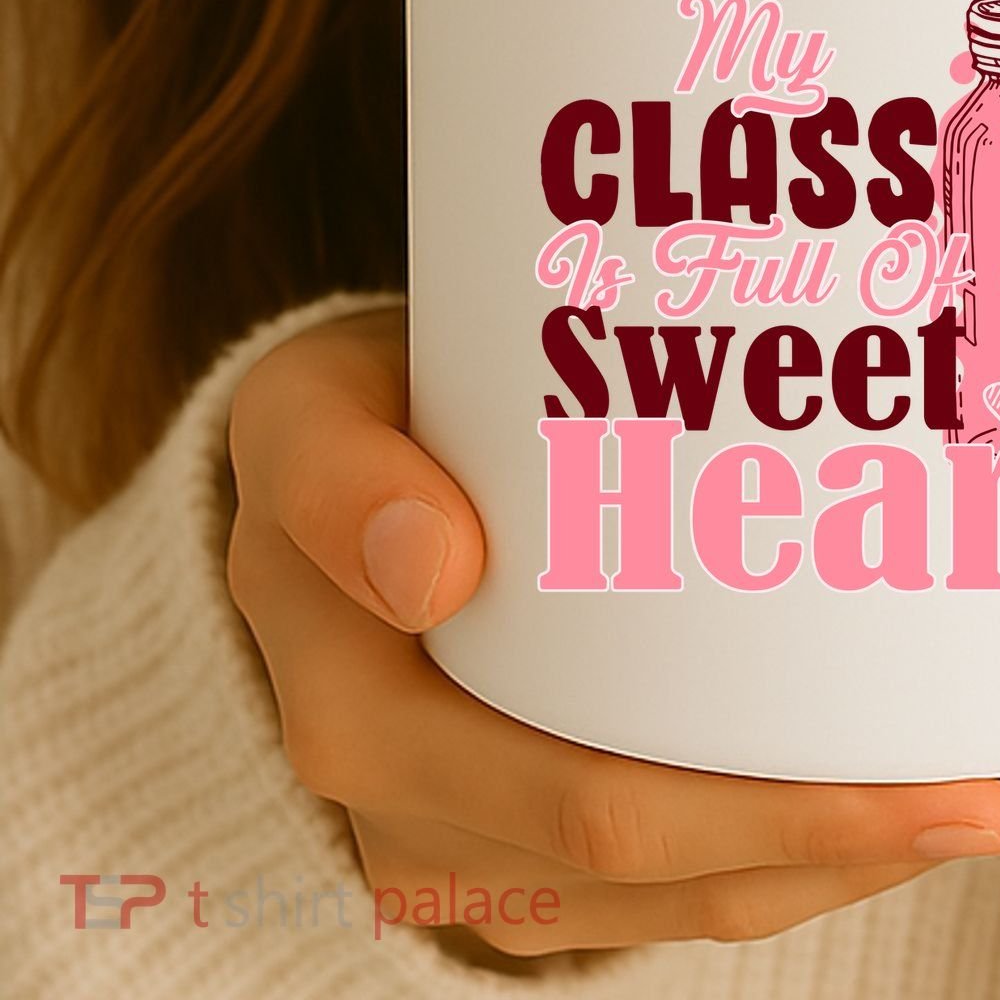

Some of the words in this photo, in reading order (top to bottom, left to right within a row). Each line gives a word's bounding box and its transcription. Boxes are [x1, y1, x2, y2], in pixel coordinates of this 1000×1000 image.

[540, 97, 937, 229] CLASS
[535, 219, 635, 312] Is
[653, 214, 842, 320] Full
[858, 220, 976, 319] Of
[541, 305, 966, 432] Sweet
